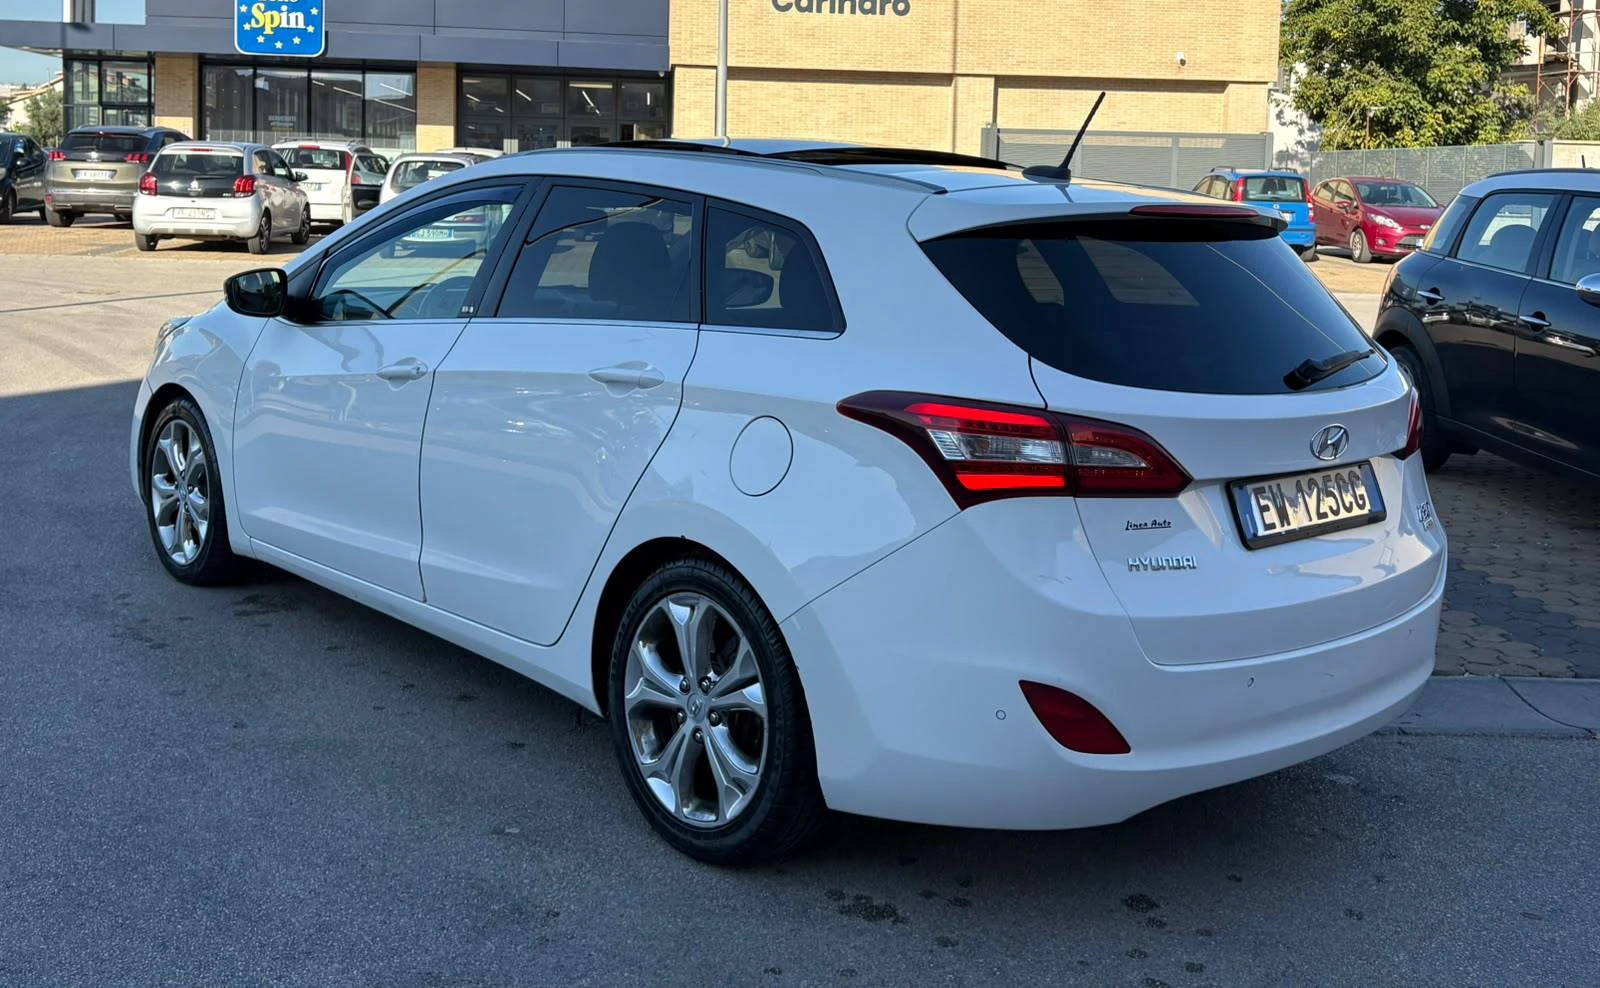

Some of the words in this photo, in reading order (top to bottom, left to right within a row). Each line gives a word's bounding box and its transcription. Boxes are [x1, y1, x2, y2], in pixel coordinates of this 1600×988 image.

[772, 0, 911, 16] Carinaro
[250, 2, 306, 35] Spin
[1151, 519, 1172, 529] Auto
[1127, 555, 1197, 572] HYUNDAI
